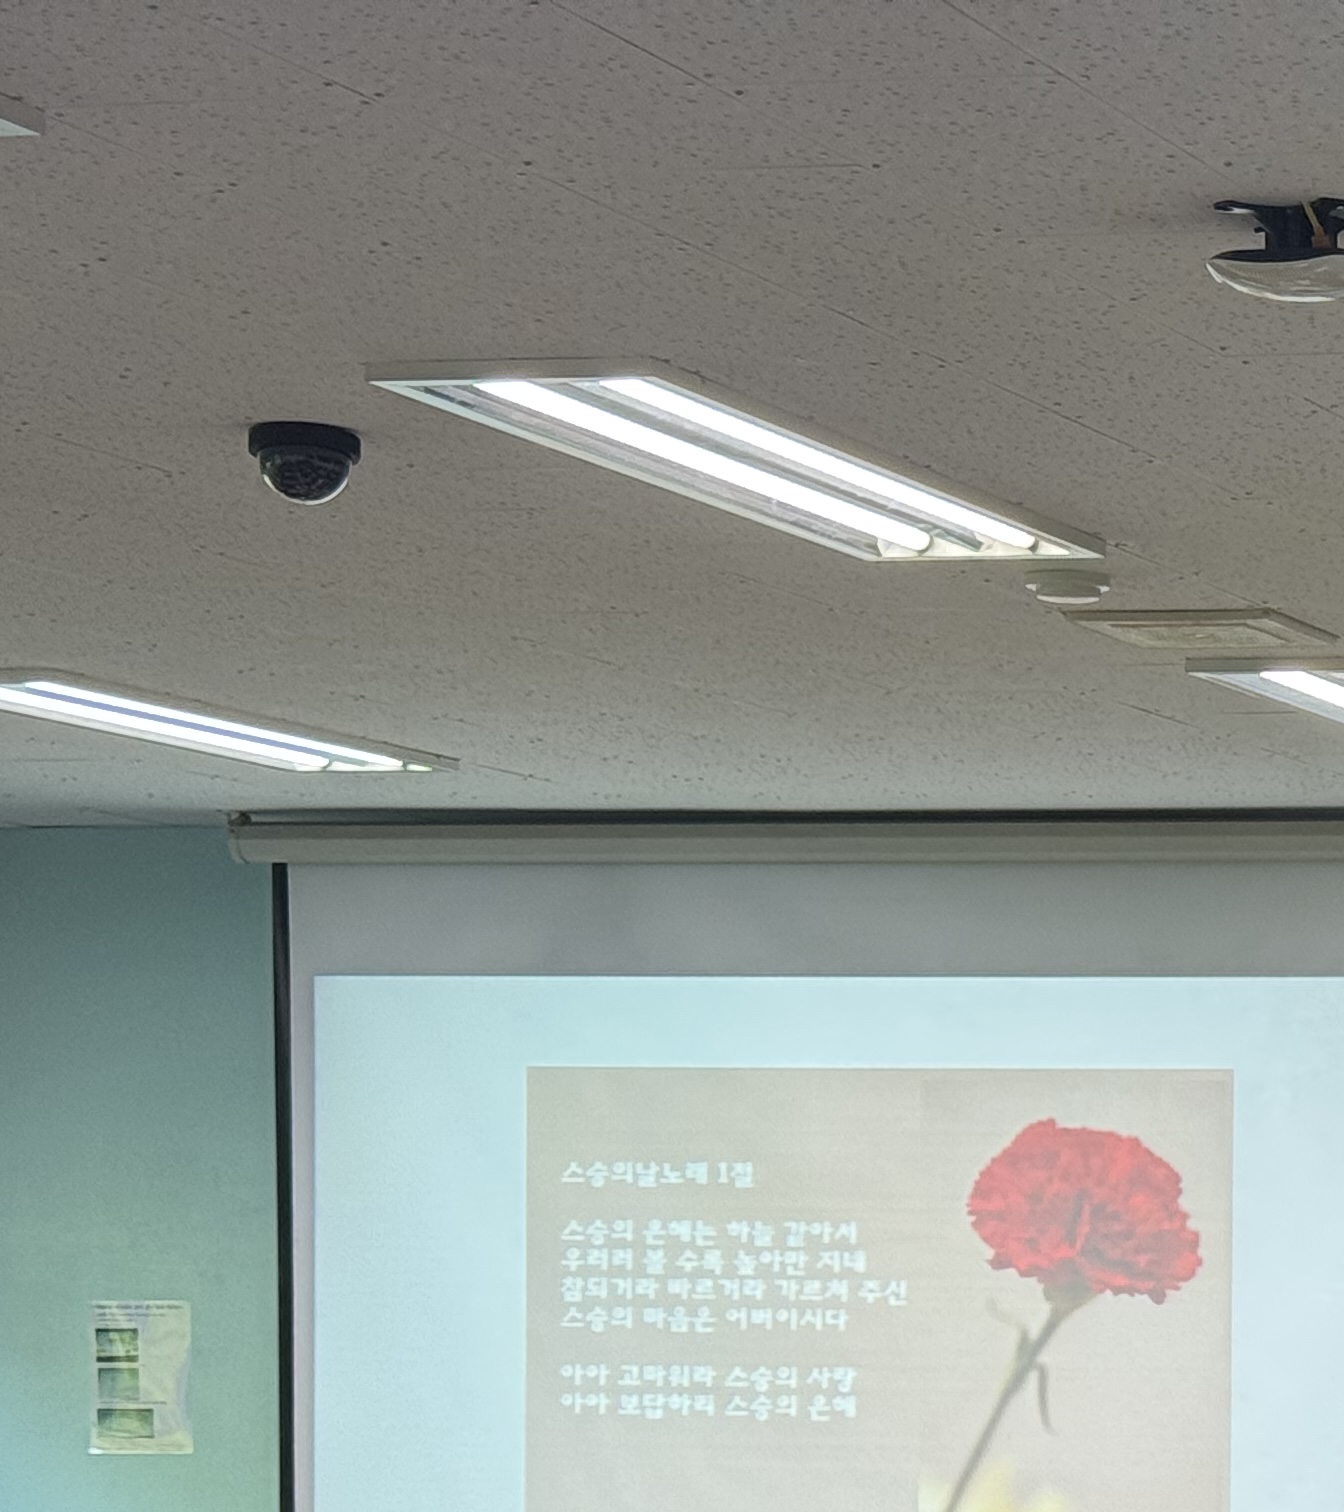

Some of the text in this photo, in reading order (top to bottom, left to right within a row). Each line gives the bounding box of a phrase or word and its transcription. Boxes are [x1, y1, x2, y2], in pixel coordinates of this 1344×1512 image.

[560, 1161, 709, 1188] 스승의날노래
[560, 1219, 858, 1247] 스승의 은혜는 하늘 같아서
[560, 1247, 633, 1272] 우러러
[734, 1249, 809, 1276] 높아만
[816, 1250, 867, 1273] 지네
[560, 1276, 908, 1306] 참되거라 바르거라 가르쳐 주신
[560, 1306, 849, 1333] 스승의 마음은 어버이시다
[560, 1364, 857, 1392] 아아 고마워라 스승의 사랑
[560, 1393, 857, 1422] 아아 보답하리 스승의 은혜
